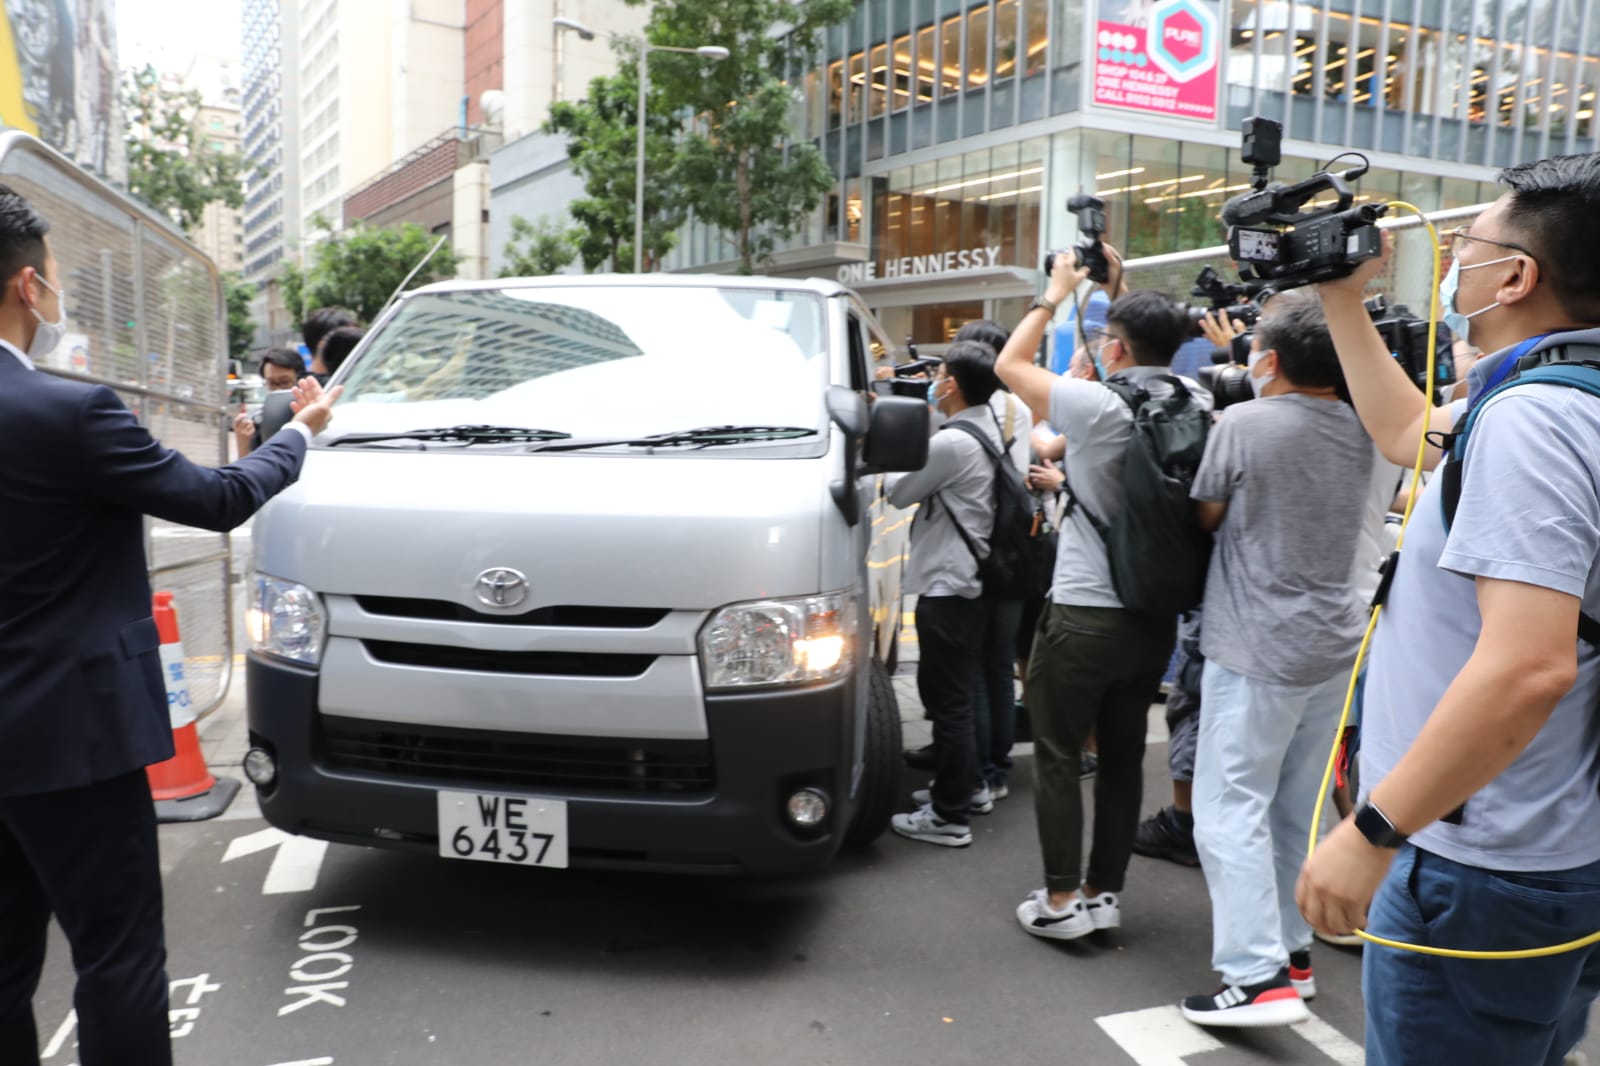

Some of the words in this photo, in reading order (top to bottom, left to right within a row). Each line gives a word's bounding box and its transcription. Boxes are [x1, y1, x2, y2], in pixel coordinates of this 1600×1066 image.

[1164, 27, 1200, 44] PURE
[1096, 88, 1124, 101] CALL
[1097, 76, 1120, 89] ONE
[837, 261, 876, 283] ONE
[884, 245, 1000, 279] HENNESSY
[477, 795, 528, 830] WE
[452, 825, 554, 864] 6437
[276, 905, 362, 1016] LOOK
